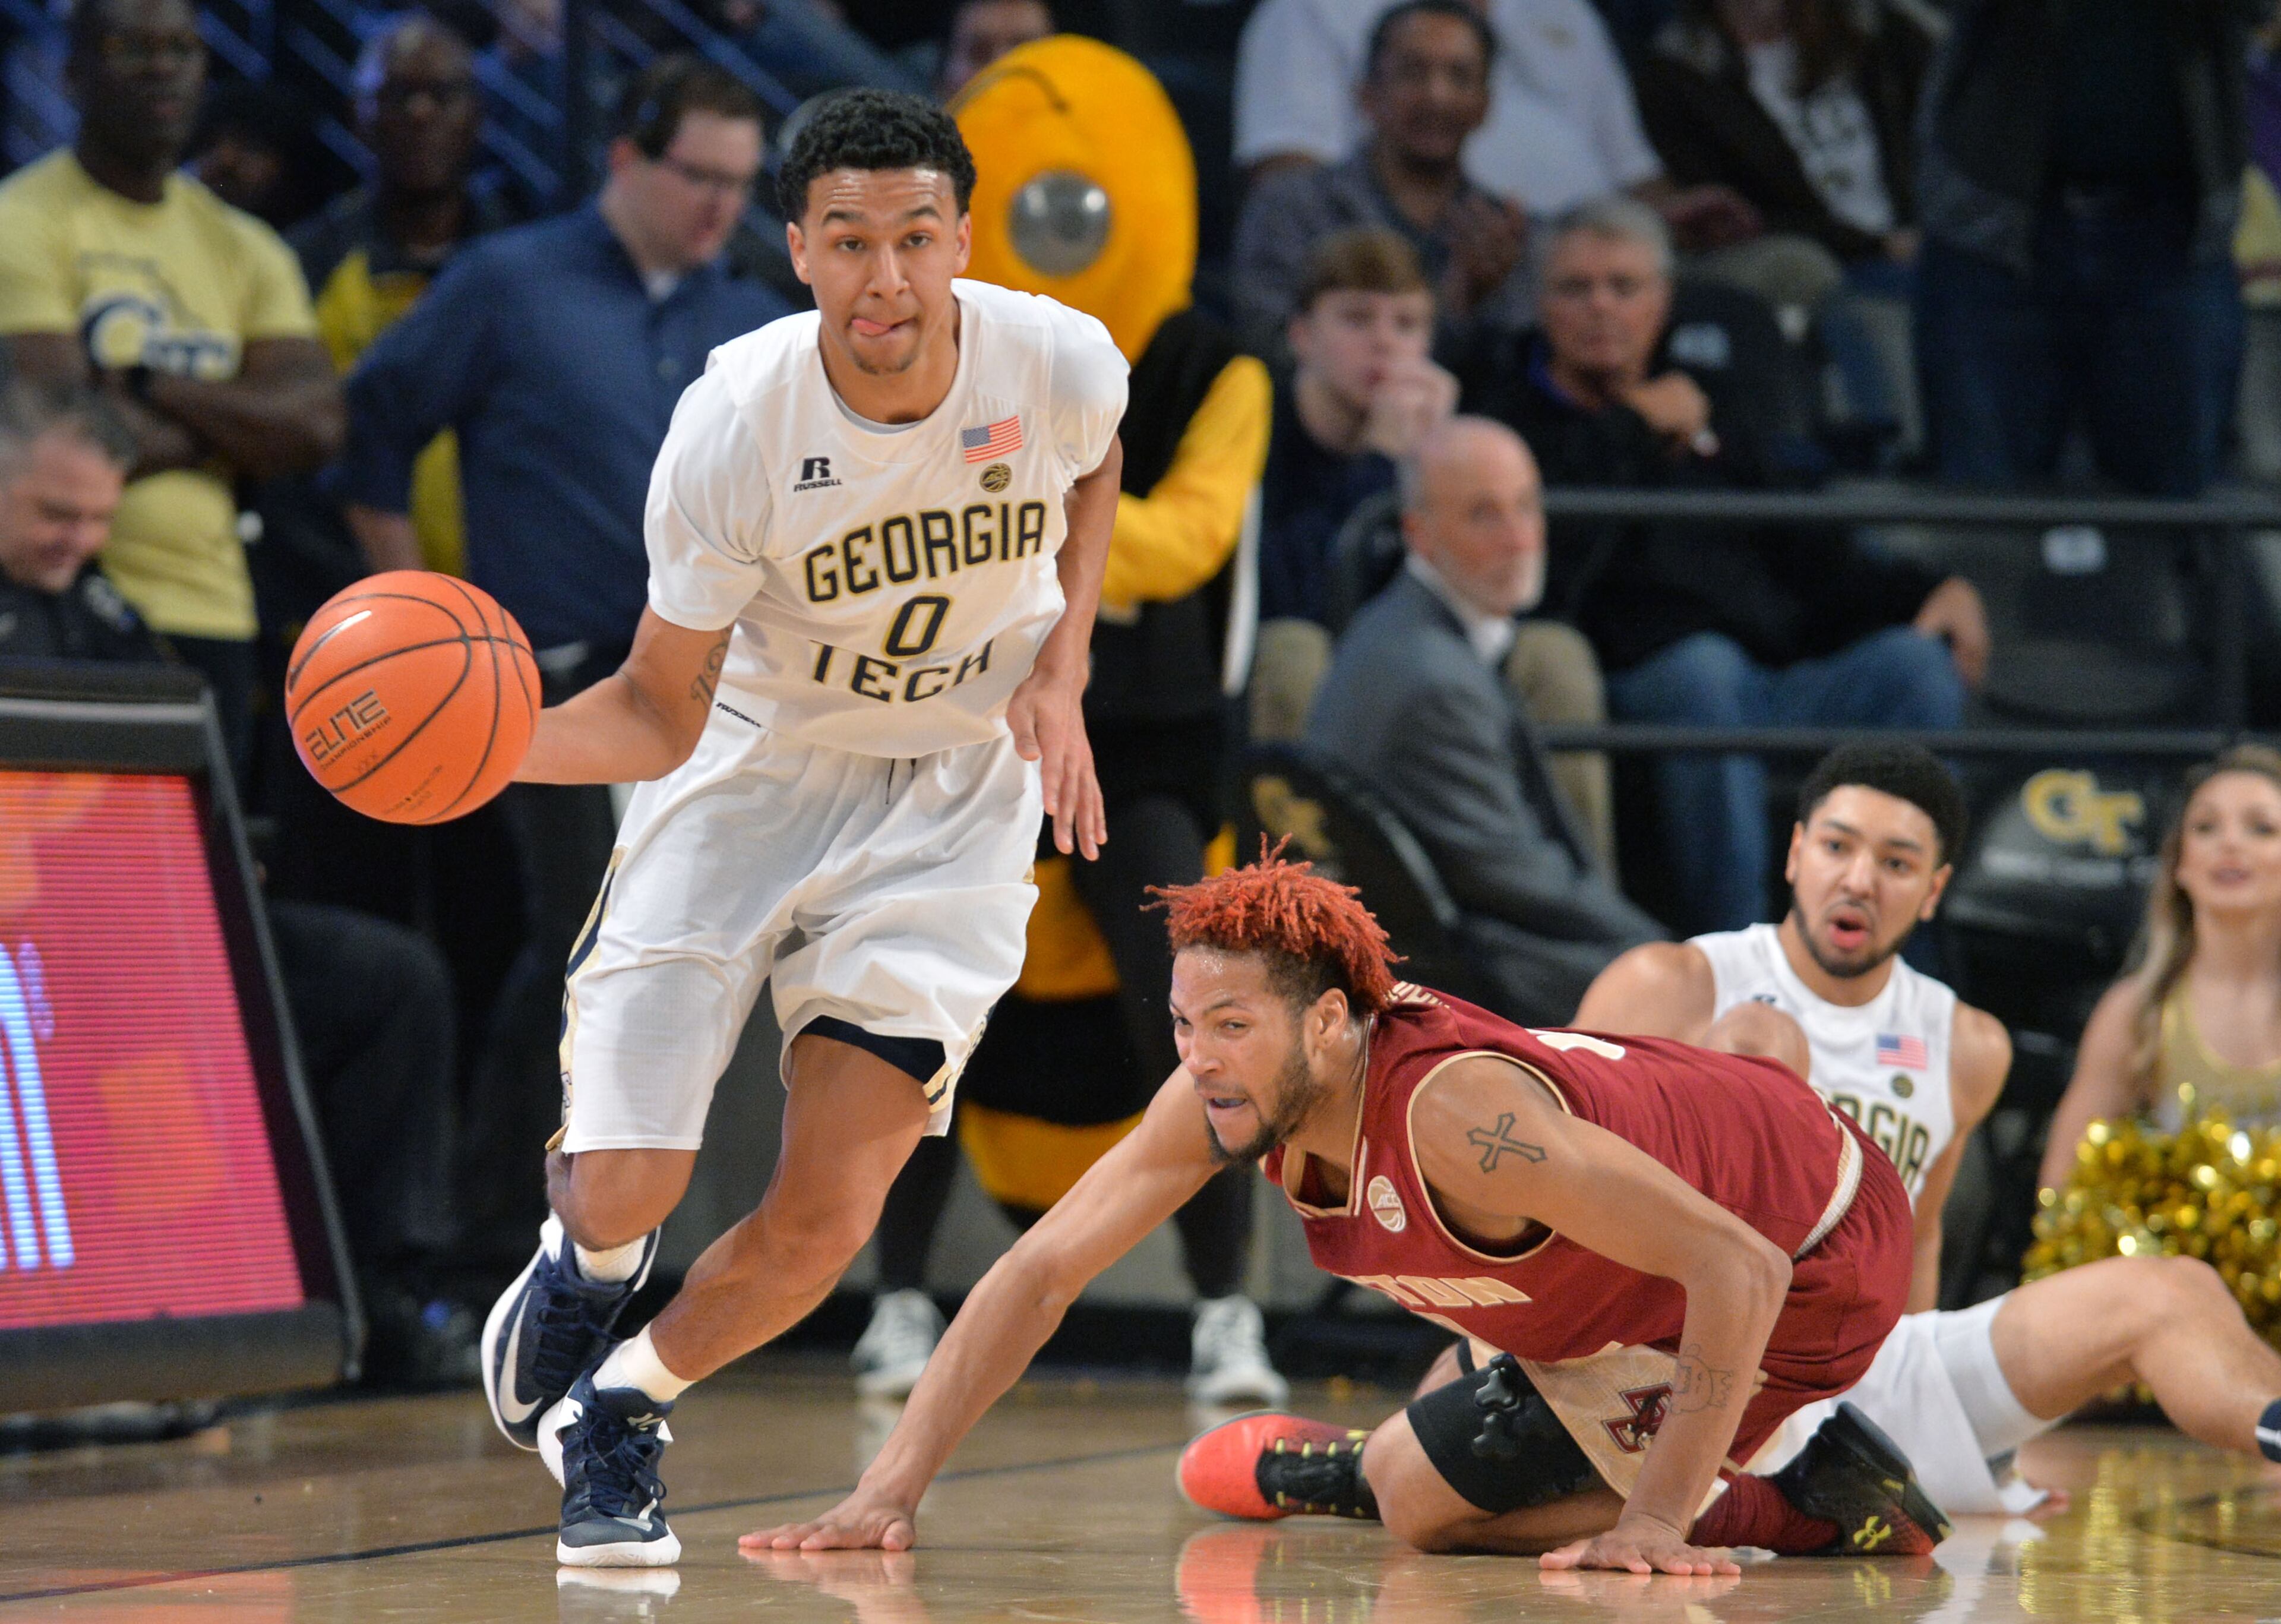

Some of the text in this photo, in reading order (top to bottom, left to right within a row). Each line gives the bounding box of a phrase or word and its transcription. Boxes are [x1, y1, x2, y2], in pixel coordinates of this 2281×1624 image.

[794, 479, 842, 492] RUSSELL
[800, 457, 830, 481] R
[804, 500, 1047, 604] GEORGIA
[883, 593, 953, 660] 0
[810, 638, 996, 703] TECH
[305, 688, 388, 761] ELITE
[321, 715, 391, 770] CHAMPIONSHIP
[1375, 1193, 1399, 1208] ACC
